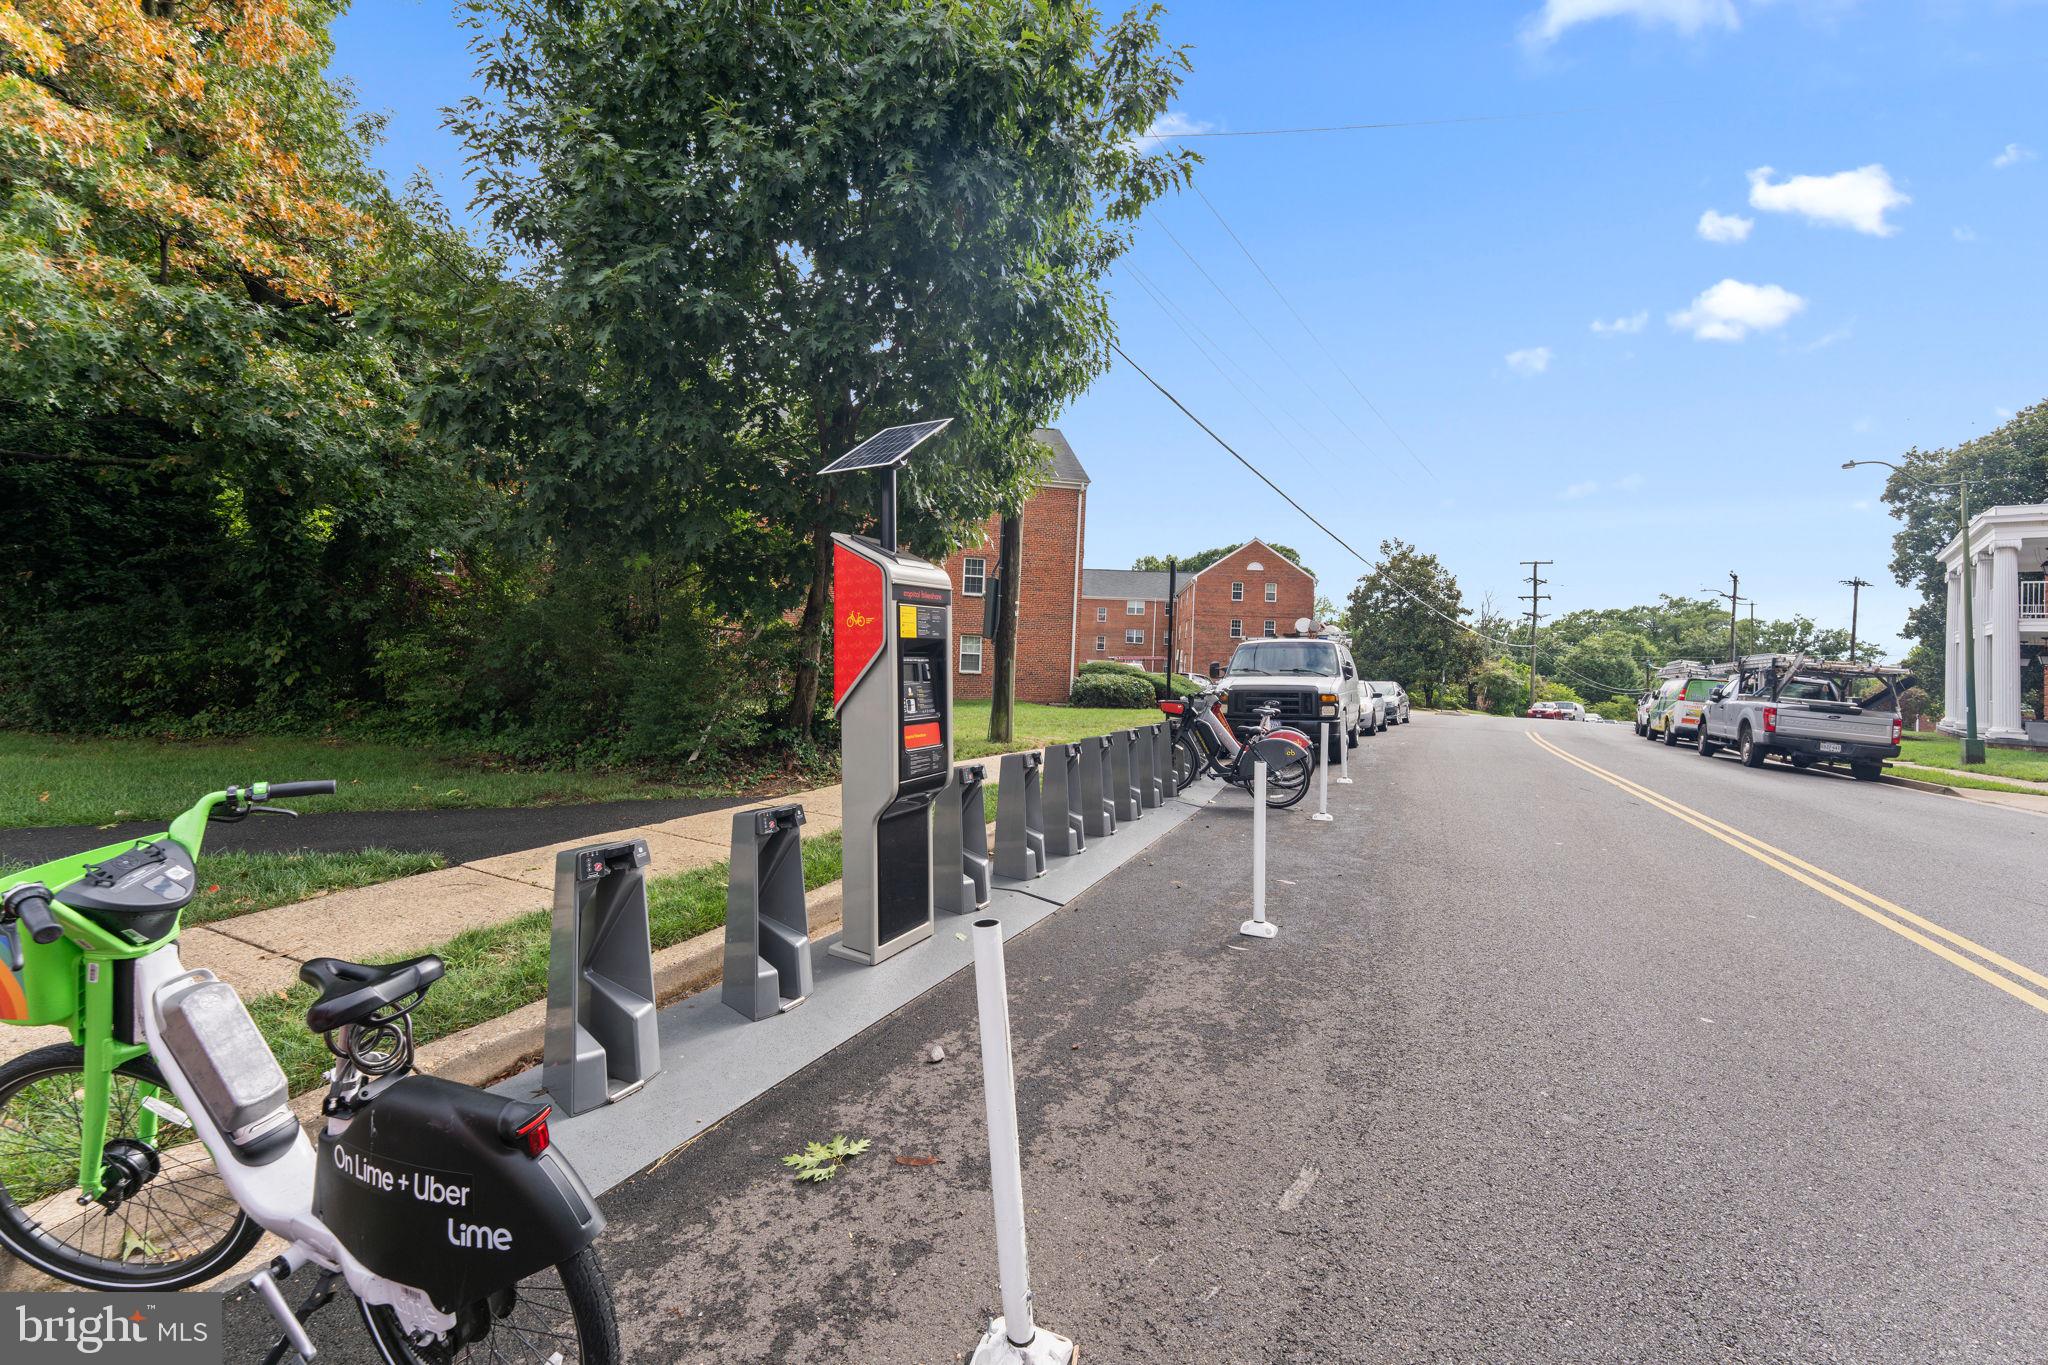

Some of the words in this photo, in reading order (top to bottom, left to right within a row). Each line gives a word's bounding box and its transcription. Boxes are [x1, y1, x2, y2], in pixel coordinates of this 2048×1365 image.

[334, 1144, 353, 1175] On
[355, 1154, 394, 1191] Lime
[413, 1173, 471, 1206] Uber
[448, 1218, 513, 1251] Lime
